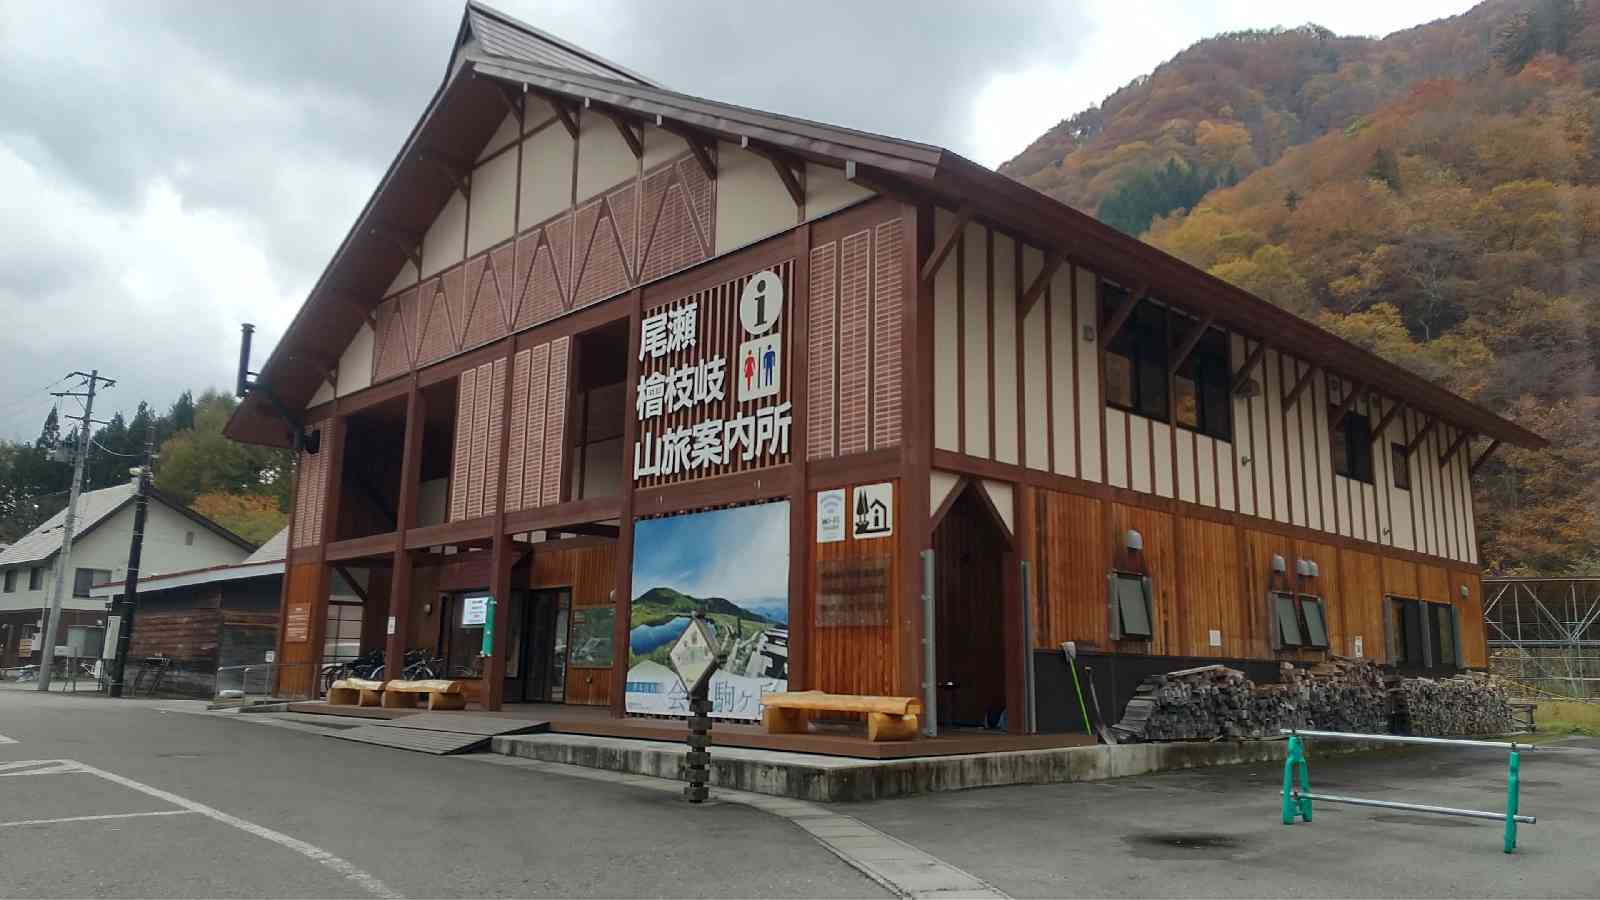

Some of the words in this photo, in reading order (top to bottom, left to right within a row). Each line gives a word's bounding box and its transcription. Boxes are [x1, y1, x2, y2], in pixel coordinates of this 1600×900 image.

[640, 303, 698, 361] 尾瀬
[636, 355, 727, 420] 檜枝岐
[634, 402, 792, 480] 山旅案内所
